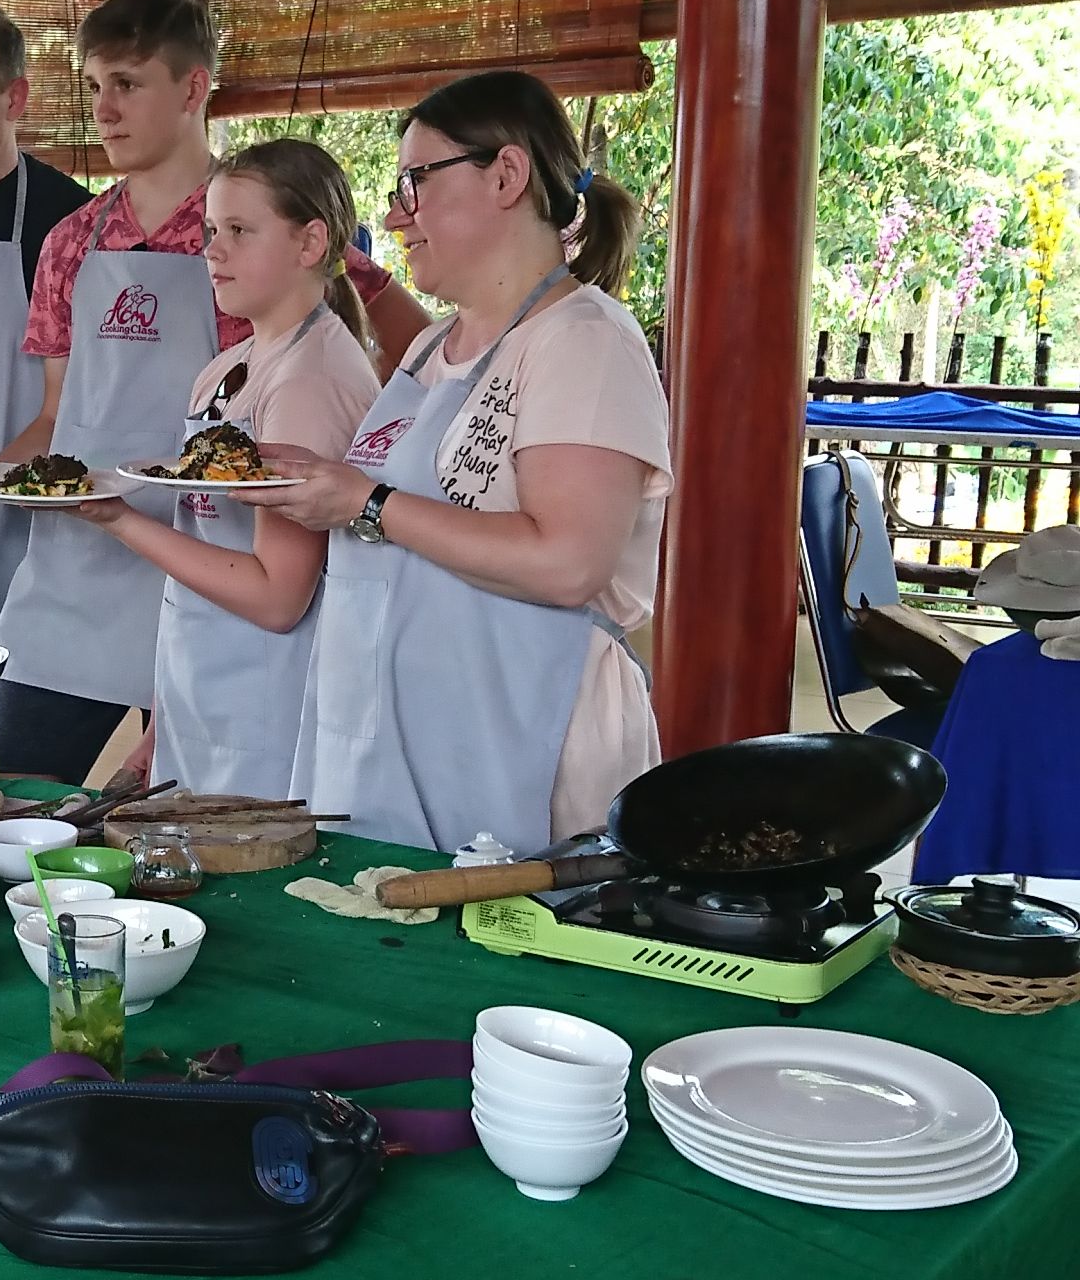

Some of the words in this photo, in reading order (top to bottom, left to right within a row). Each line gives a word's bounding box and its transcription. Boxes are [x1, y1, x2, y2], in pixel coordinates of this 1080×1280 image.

[480, 392, 516, 417] red
[467, 414, 500, 439] ople
[474, 435, 508, 456] may
